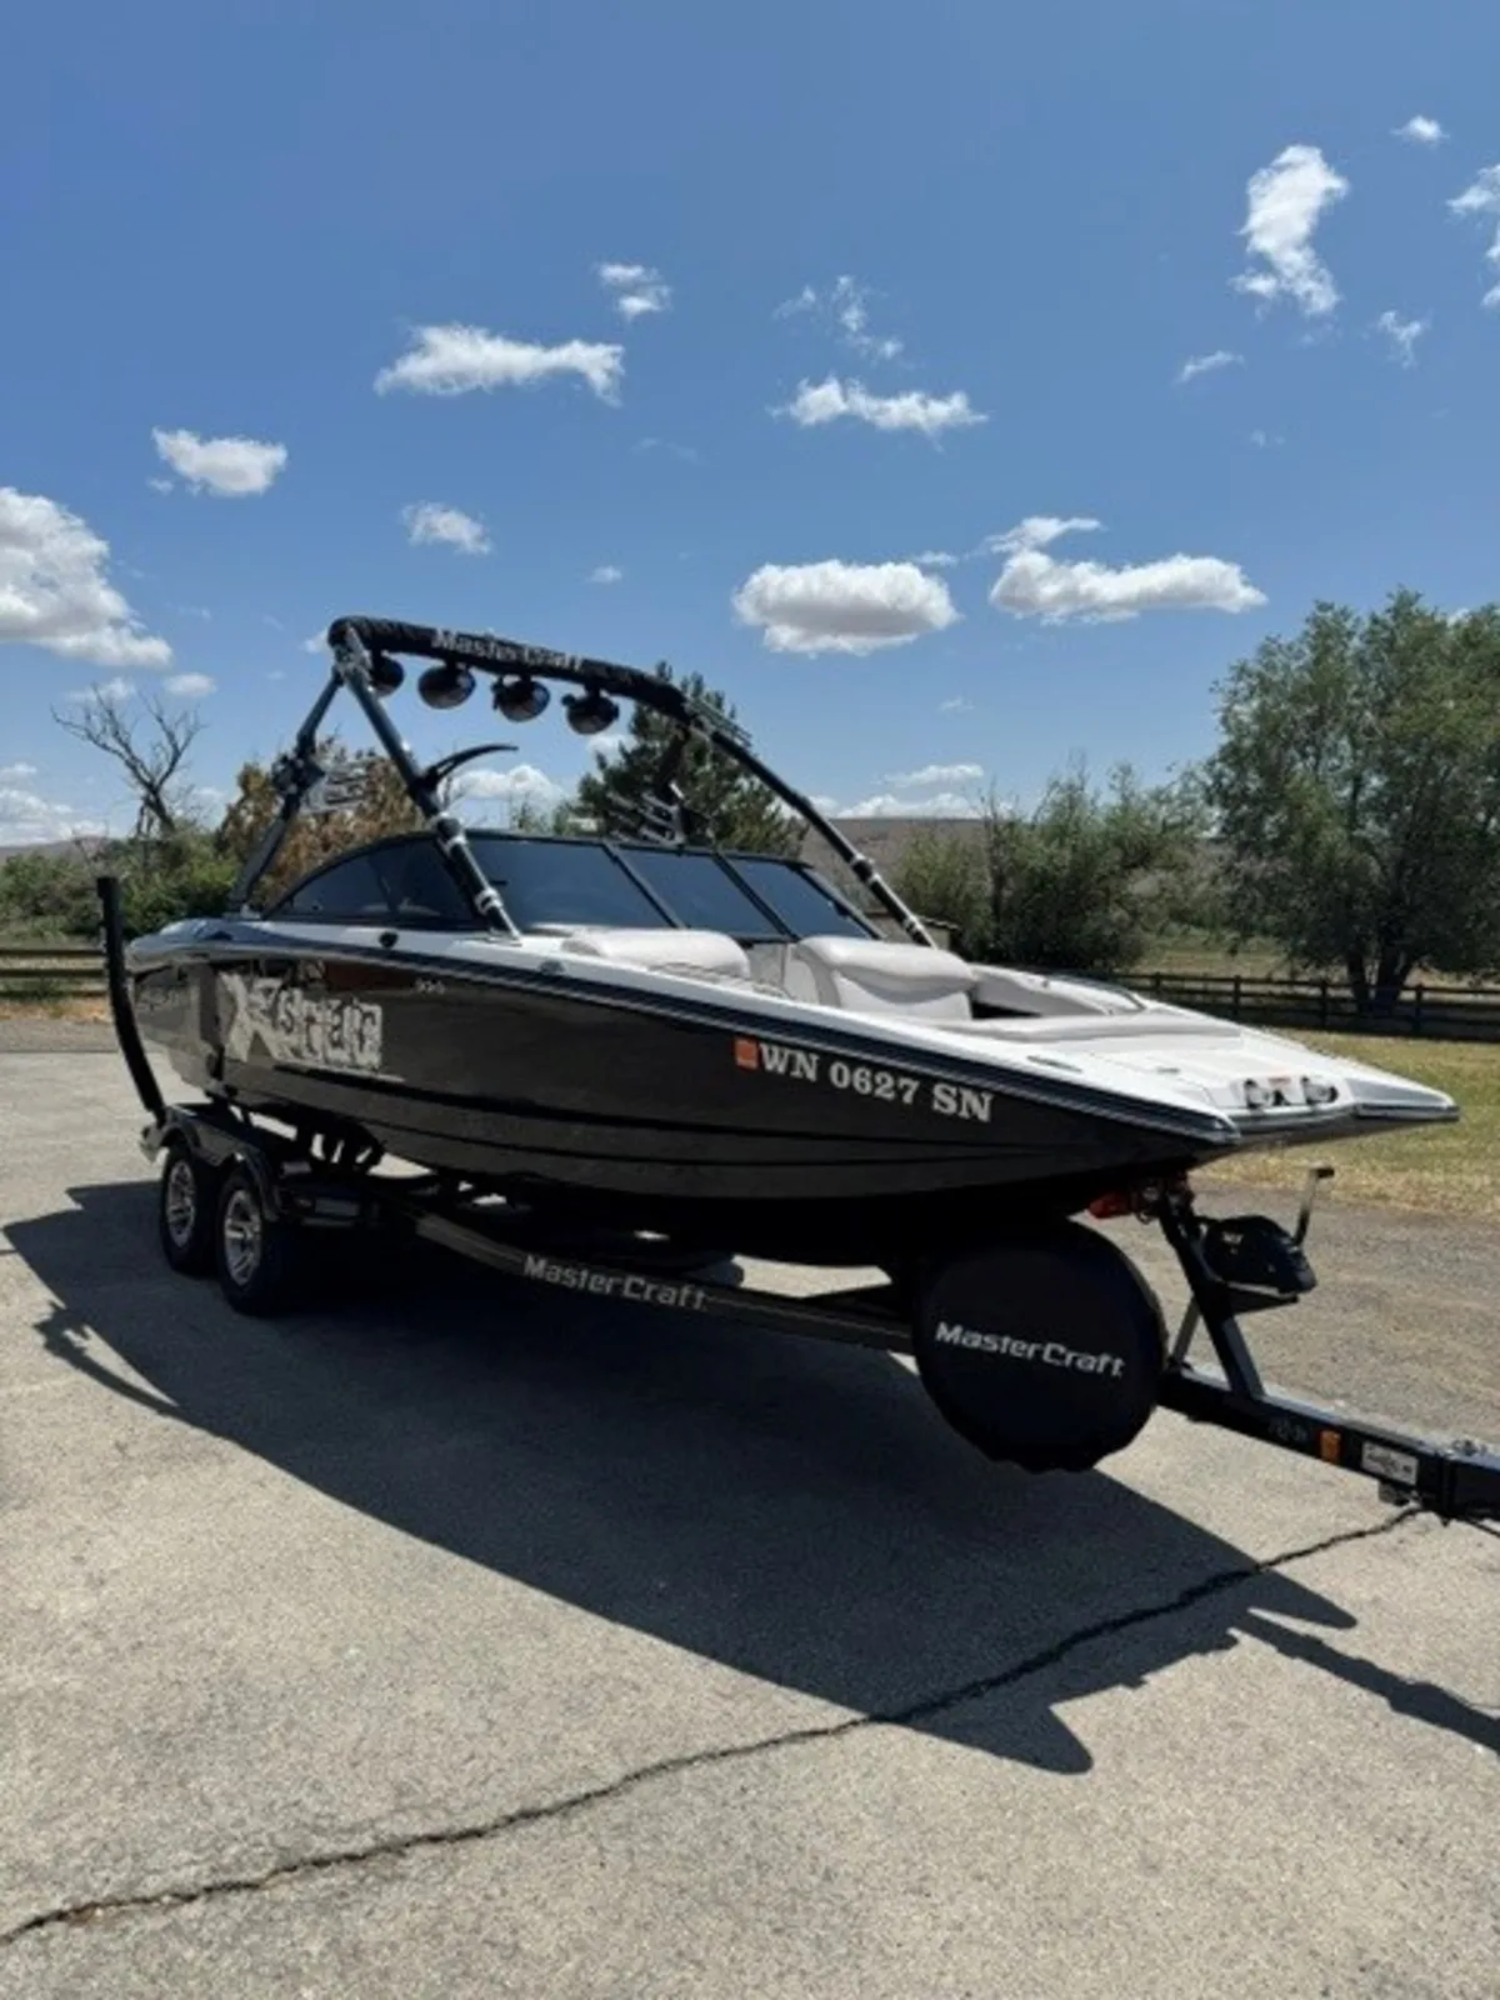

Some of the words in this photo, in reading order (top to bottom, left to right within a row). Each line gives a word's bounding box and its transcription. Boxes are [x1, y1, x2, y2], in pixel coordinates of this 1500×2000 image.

[759, 1043, 820, 1082] WN
[829, 1062, 920, 1104] 0627
[931, 1083, 994, 1122] SN
[523, 1254, 708, 1310] MasterCraft
[935, 1321, 1126, 1378] MasterCraft
